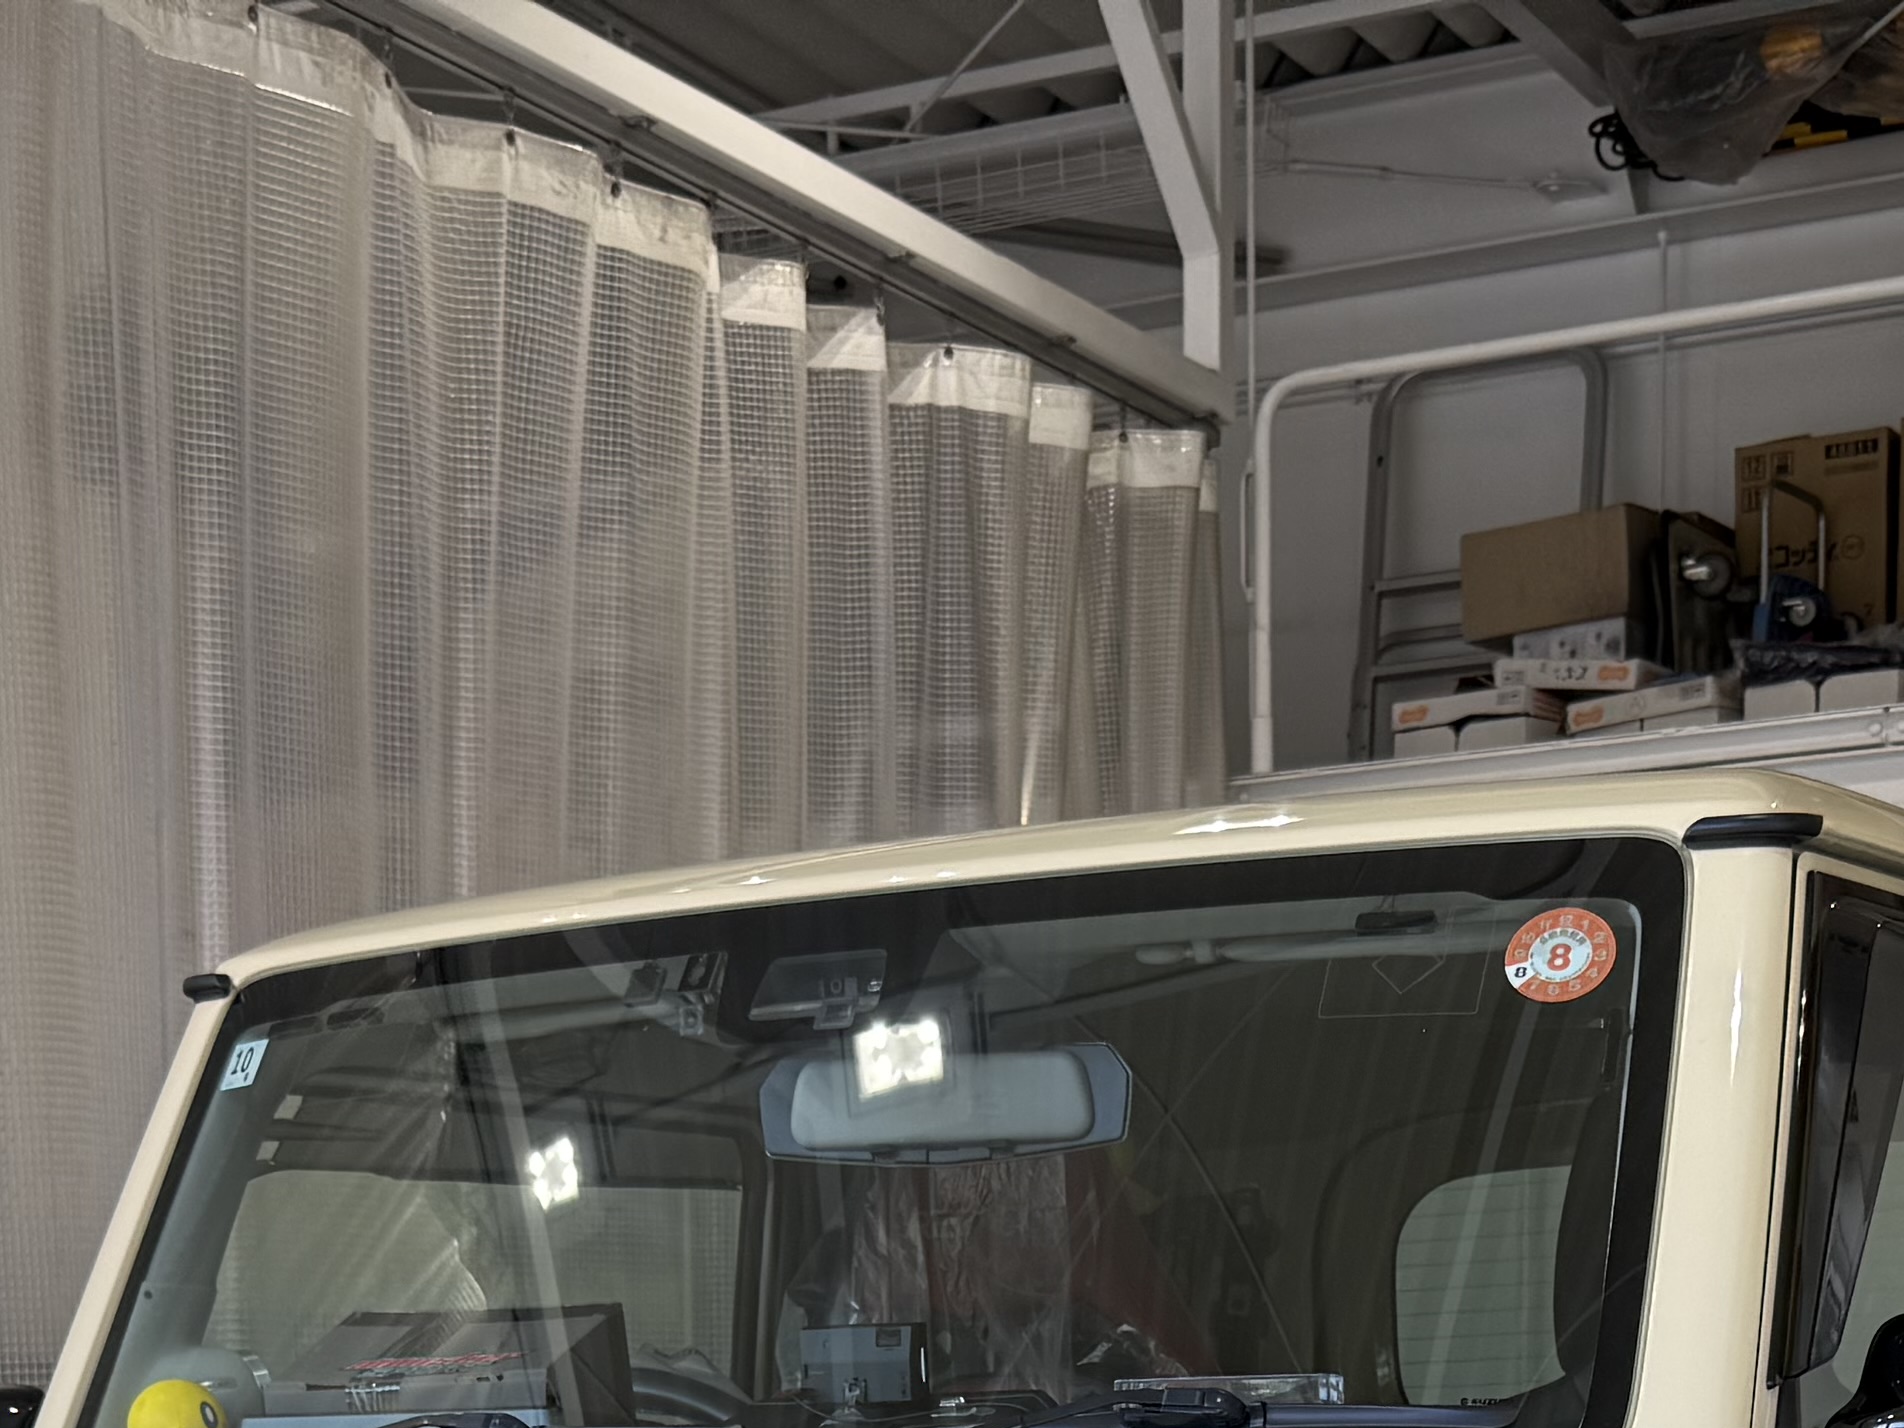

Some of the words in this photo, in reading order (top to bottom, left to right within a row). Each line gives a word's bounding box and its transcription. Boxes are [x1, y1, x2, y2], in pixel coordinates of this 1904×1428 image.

[1547, 943, 1573, 971] 8
[1514, 966, 1527, 978] 8
[231, 1046, 254, 1075] 10
